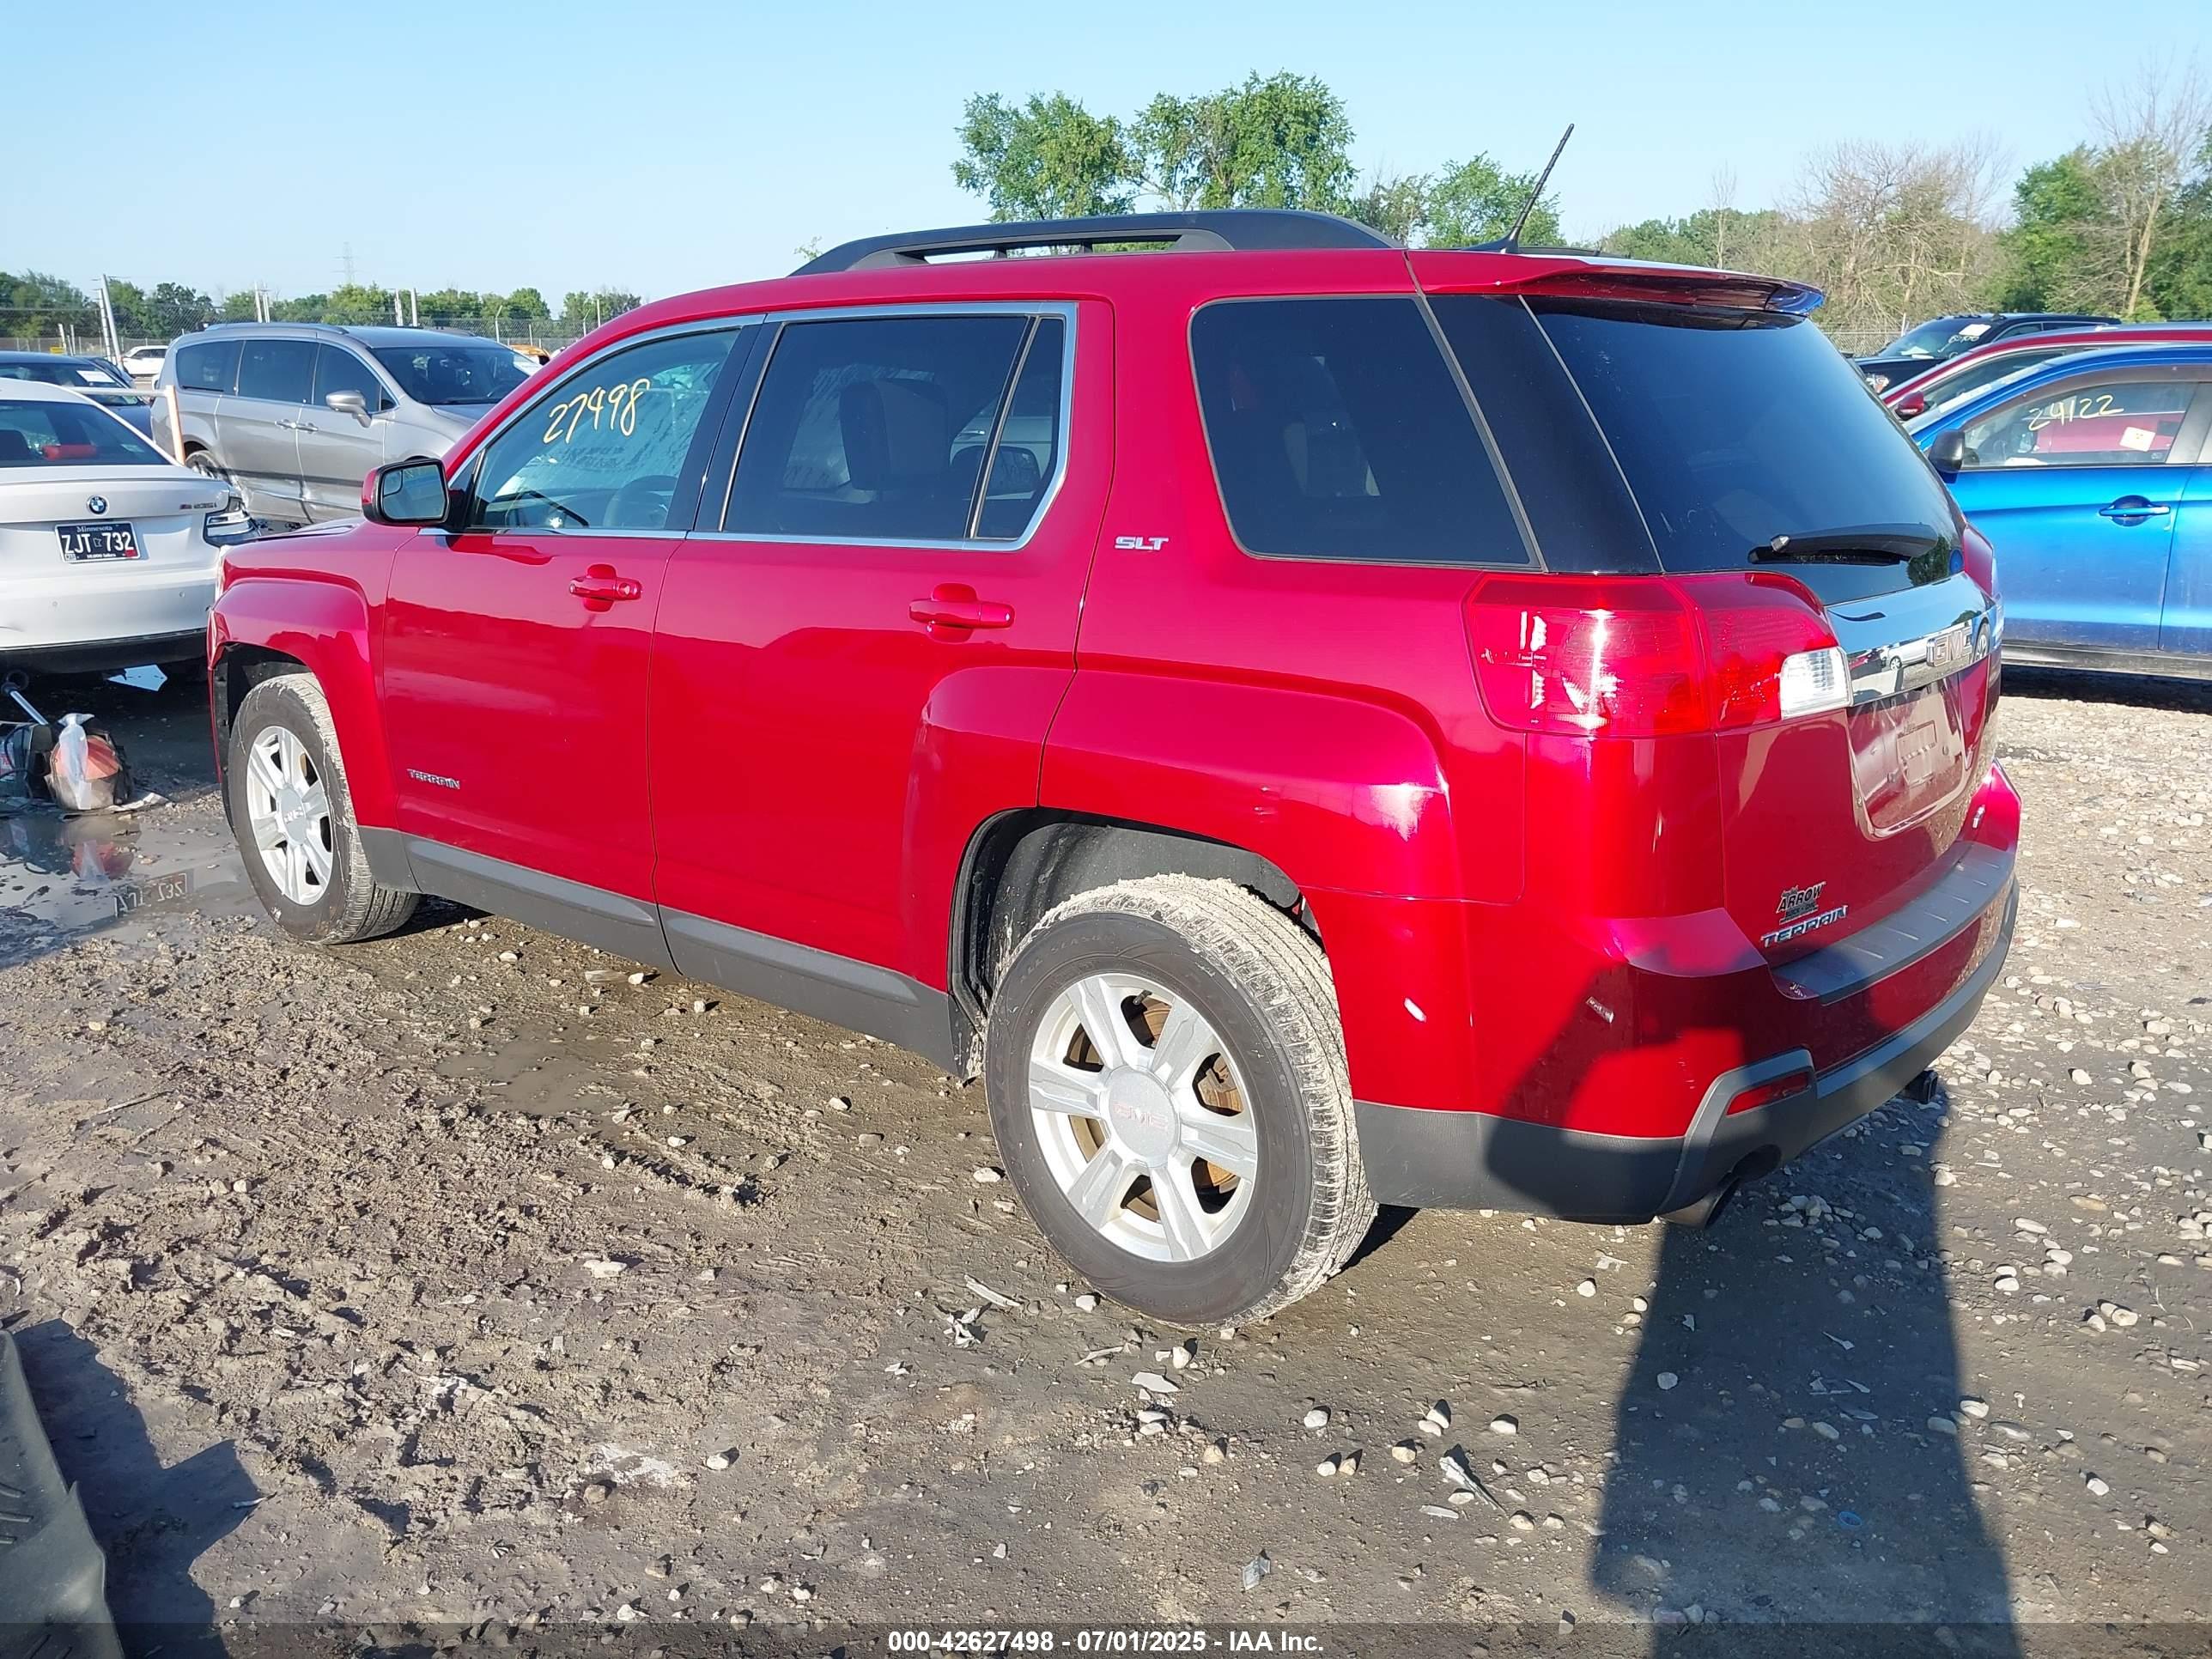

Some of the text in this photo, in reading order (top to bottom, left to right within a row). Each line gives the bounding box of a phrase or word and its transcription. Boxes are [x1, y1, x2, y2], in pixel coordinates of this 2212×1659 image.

[544, 378, 650, 444] 27498
[2028, 394, 2124, 431] 24122
[61, 532, 134, 554] ZJT 732
[1115, 536, 1169, 550] SLT
[1926, 619, 1973, 667] GMC
[406, 768, 461, 789] TERRAIN
[1776, 881, 1826, 913] ARROW
[1760, 905, 1849, 947] TERRAIN
